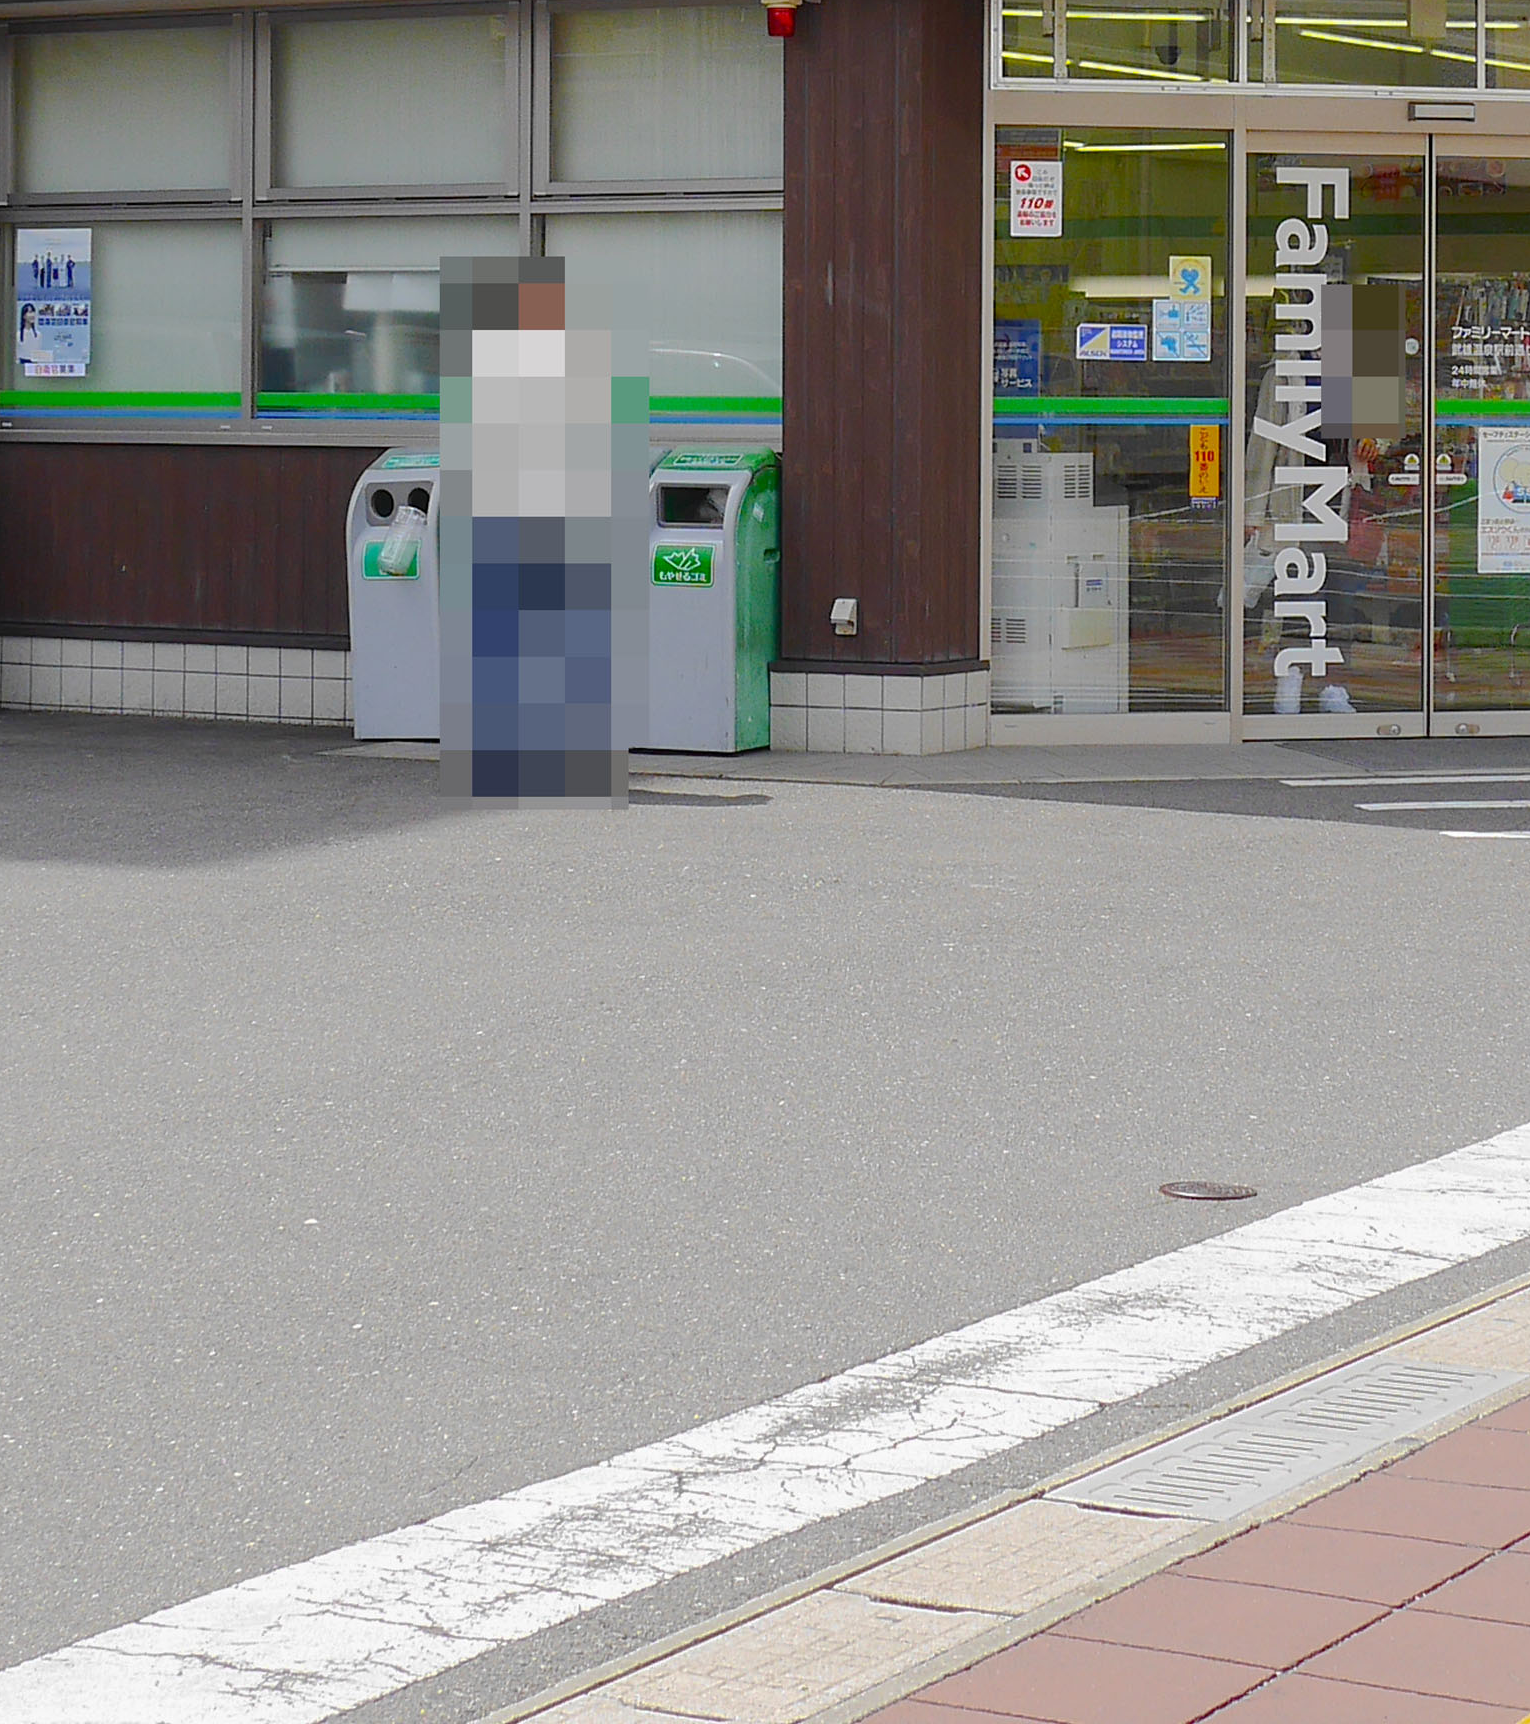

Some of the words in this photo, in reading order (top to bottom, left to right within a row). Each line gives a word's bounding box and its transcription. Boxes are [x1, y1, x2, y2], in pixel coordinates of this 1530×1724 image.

[1451, 326, 1530, 340] ファミリーマート
[1253, 166, 1350, 677] FamilyMart
[659, 571, 707, 582] もやせるゴミ
